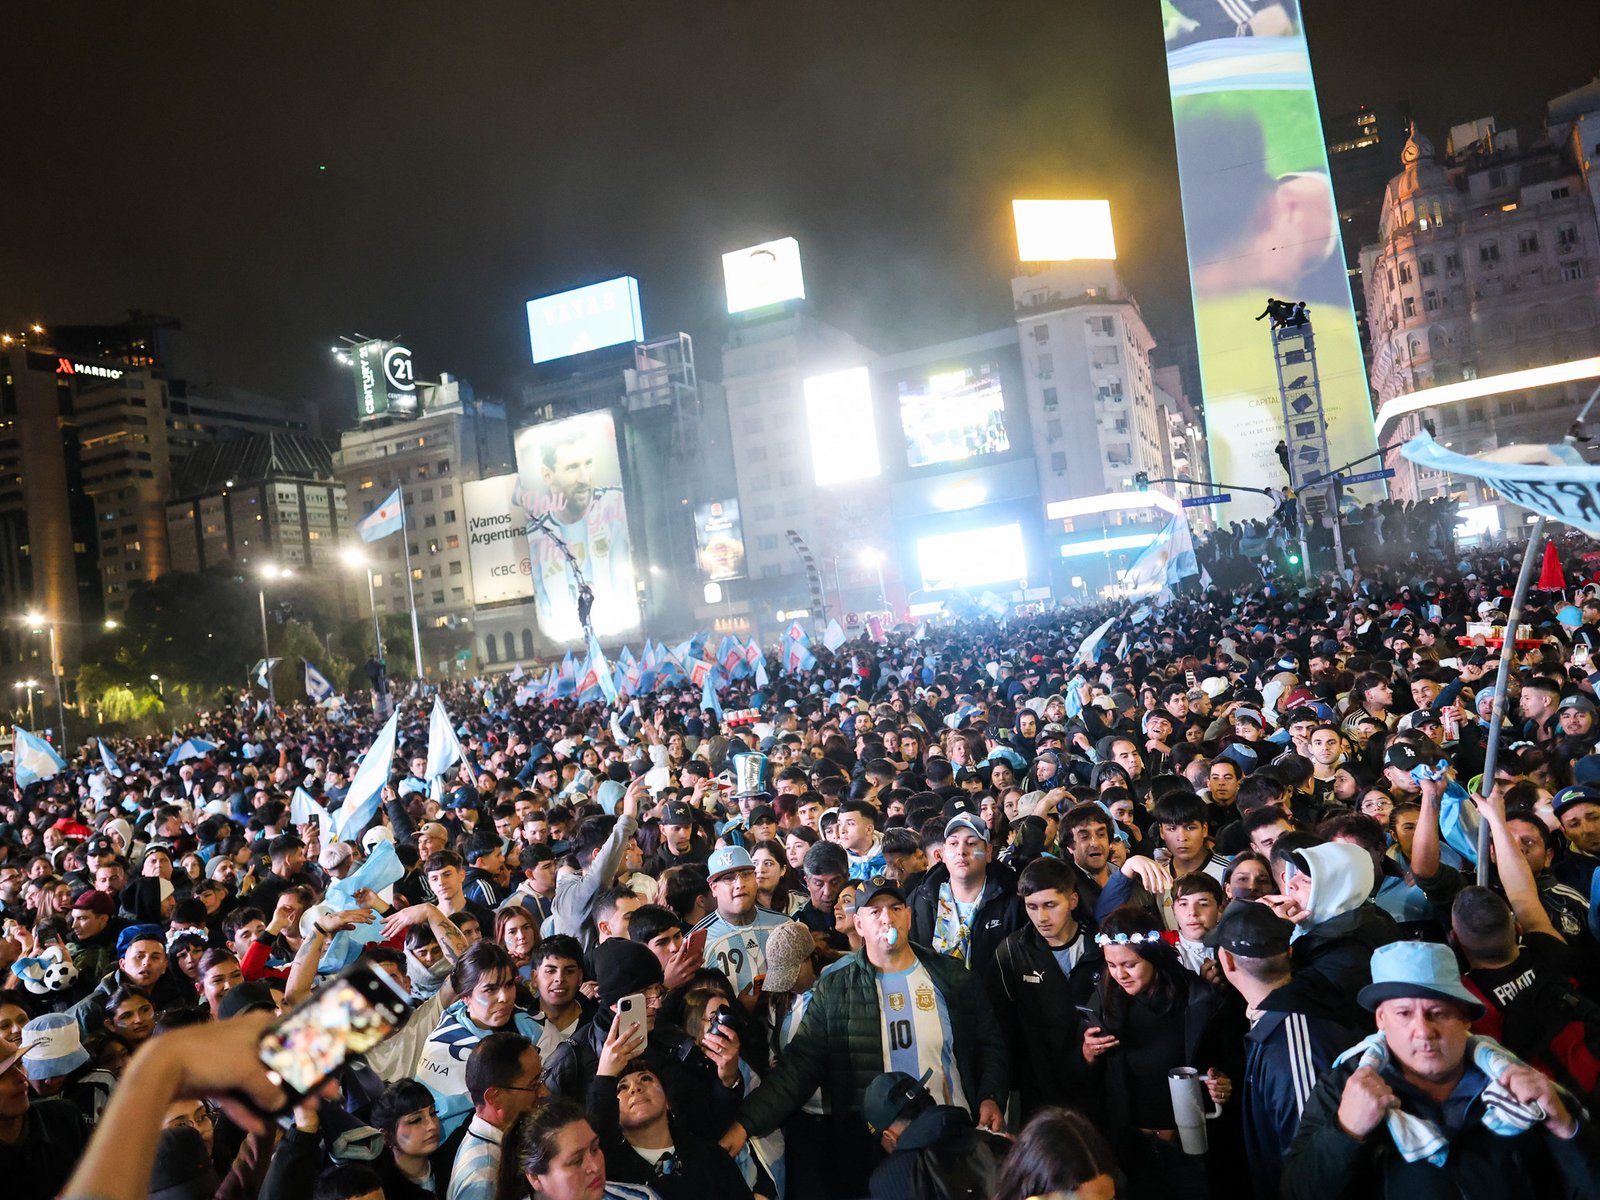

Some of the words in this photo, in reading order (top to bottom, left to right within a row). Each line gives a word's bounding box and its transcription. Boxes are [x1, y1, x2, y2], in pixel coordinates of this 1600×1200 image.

[469, 513, 512, 532] ¡Vamos
[471, 526, 527, 545] Argentina
[491, 564, 517, 577] ICBC
[1403, 746, 1416, 757] LA
[716, 948, 744, 977] 19
[889, 1019, 913, 1051] 10
[420, 1058, 450, 1077] TINA
